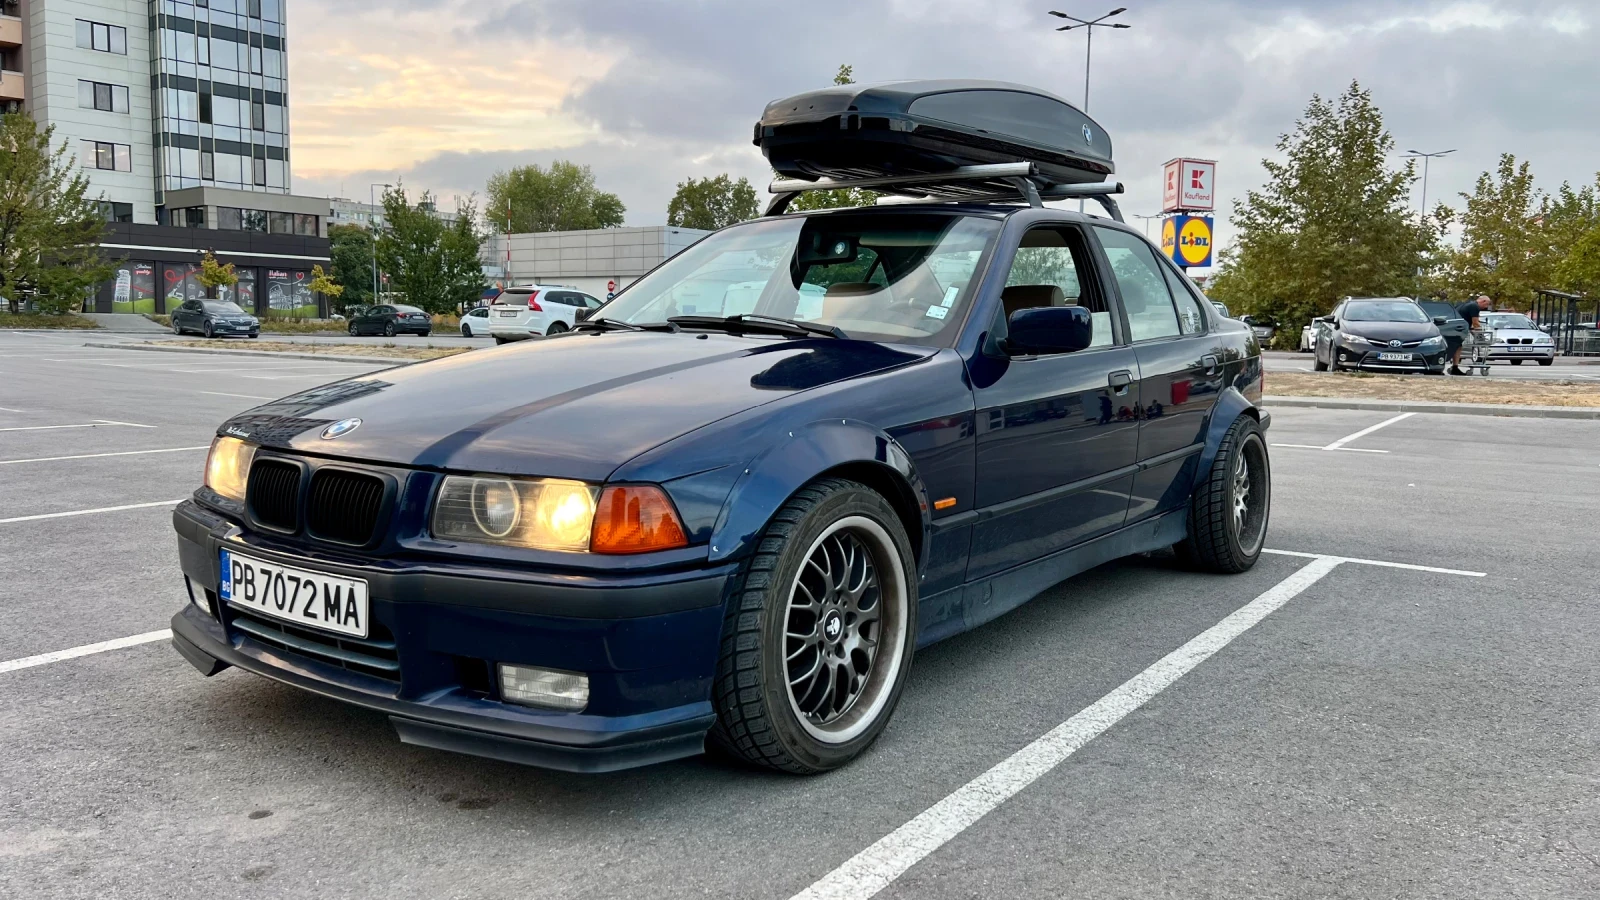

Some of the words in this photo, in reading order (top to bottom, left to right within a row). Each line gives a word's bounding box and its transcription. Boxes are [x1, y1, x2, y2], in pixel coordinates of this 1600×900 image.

[1192, 170, 1205, 189] K
[1185, 192, 1210, 200] Kaufland
[222, 580, 231, 592] BG
[232, 559, 256, 602] PB
[260, 568, 318, 619] 7072
[324, 582, 360, 628] MA
